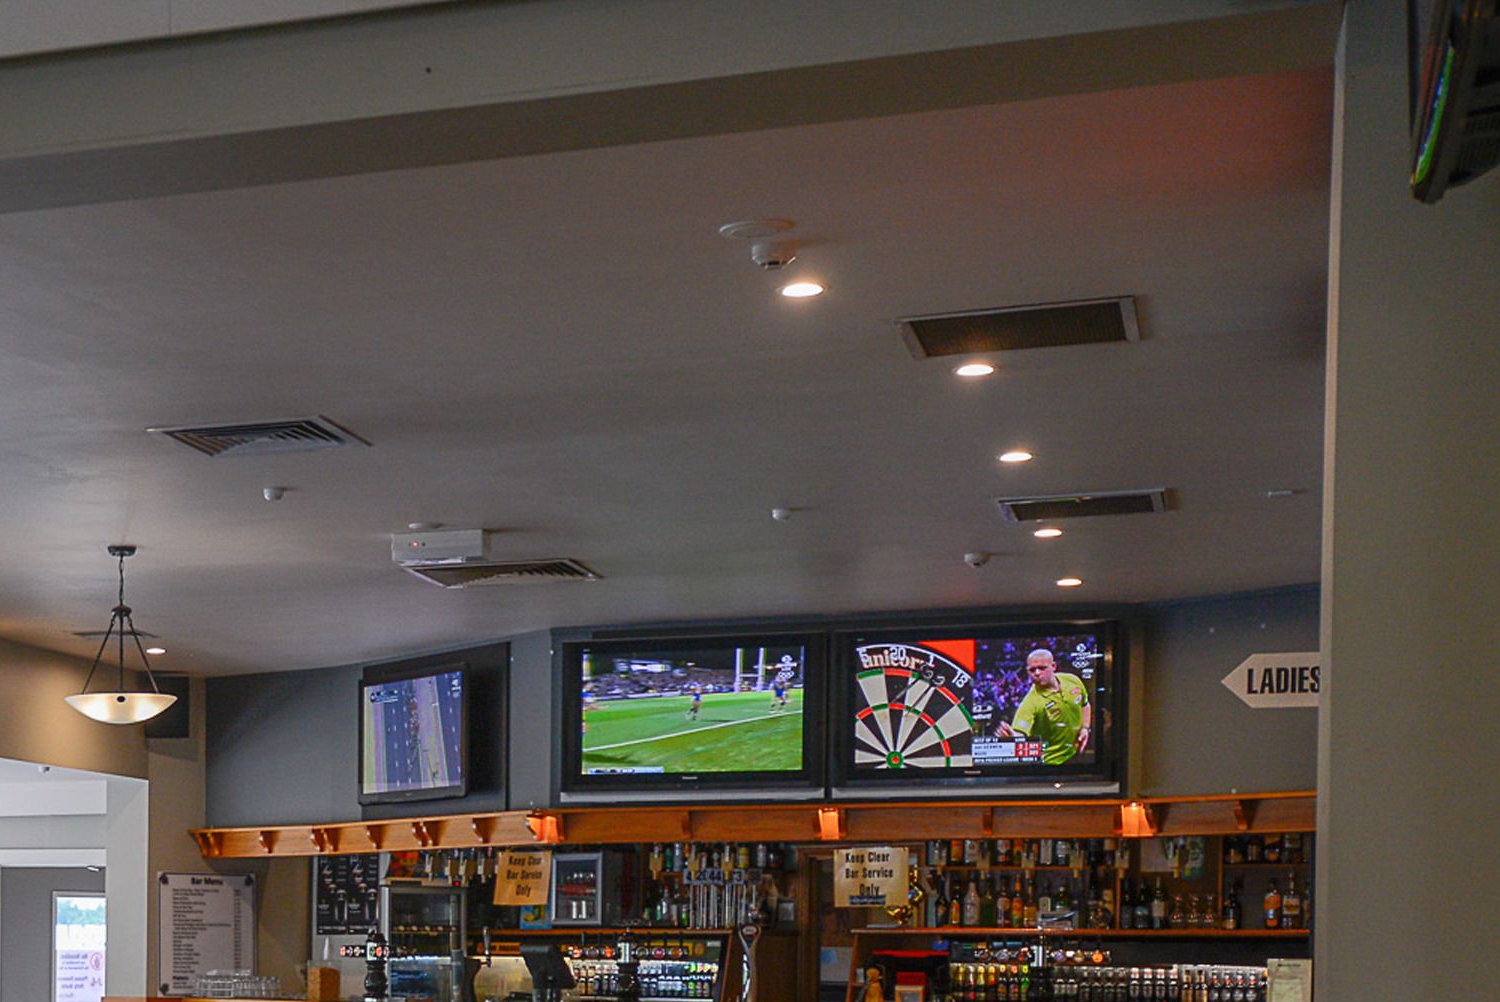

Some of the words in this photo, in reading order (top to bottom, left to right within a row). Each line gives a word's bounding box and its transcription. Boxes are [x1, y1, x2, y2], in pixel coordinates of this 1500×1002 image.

[952, 670, 968, 688] 18
[1247, 666, 1320, 694] LADIES
[845, 853, 865, 864] Keep
[868, 852, 890, 862] Clear
[845, 868, 859, 879] Bar
[862, 867, 893, 879] Service
[191, 877, 202, 885] Bar
[204, 877, 223, 885] Menu
[859, 883, 879, 896] Only
